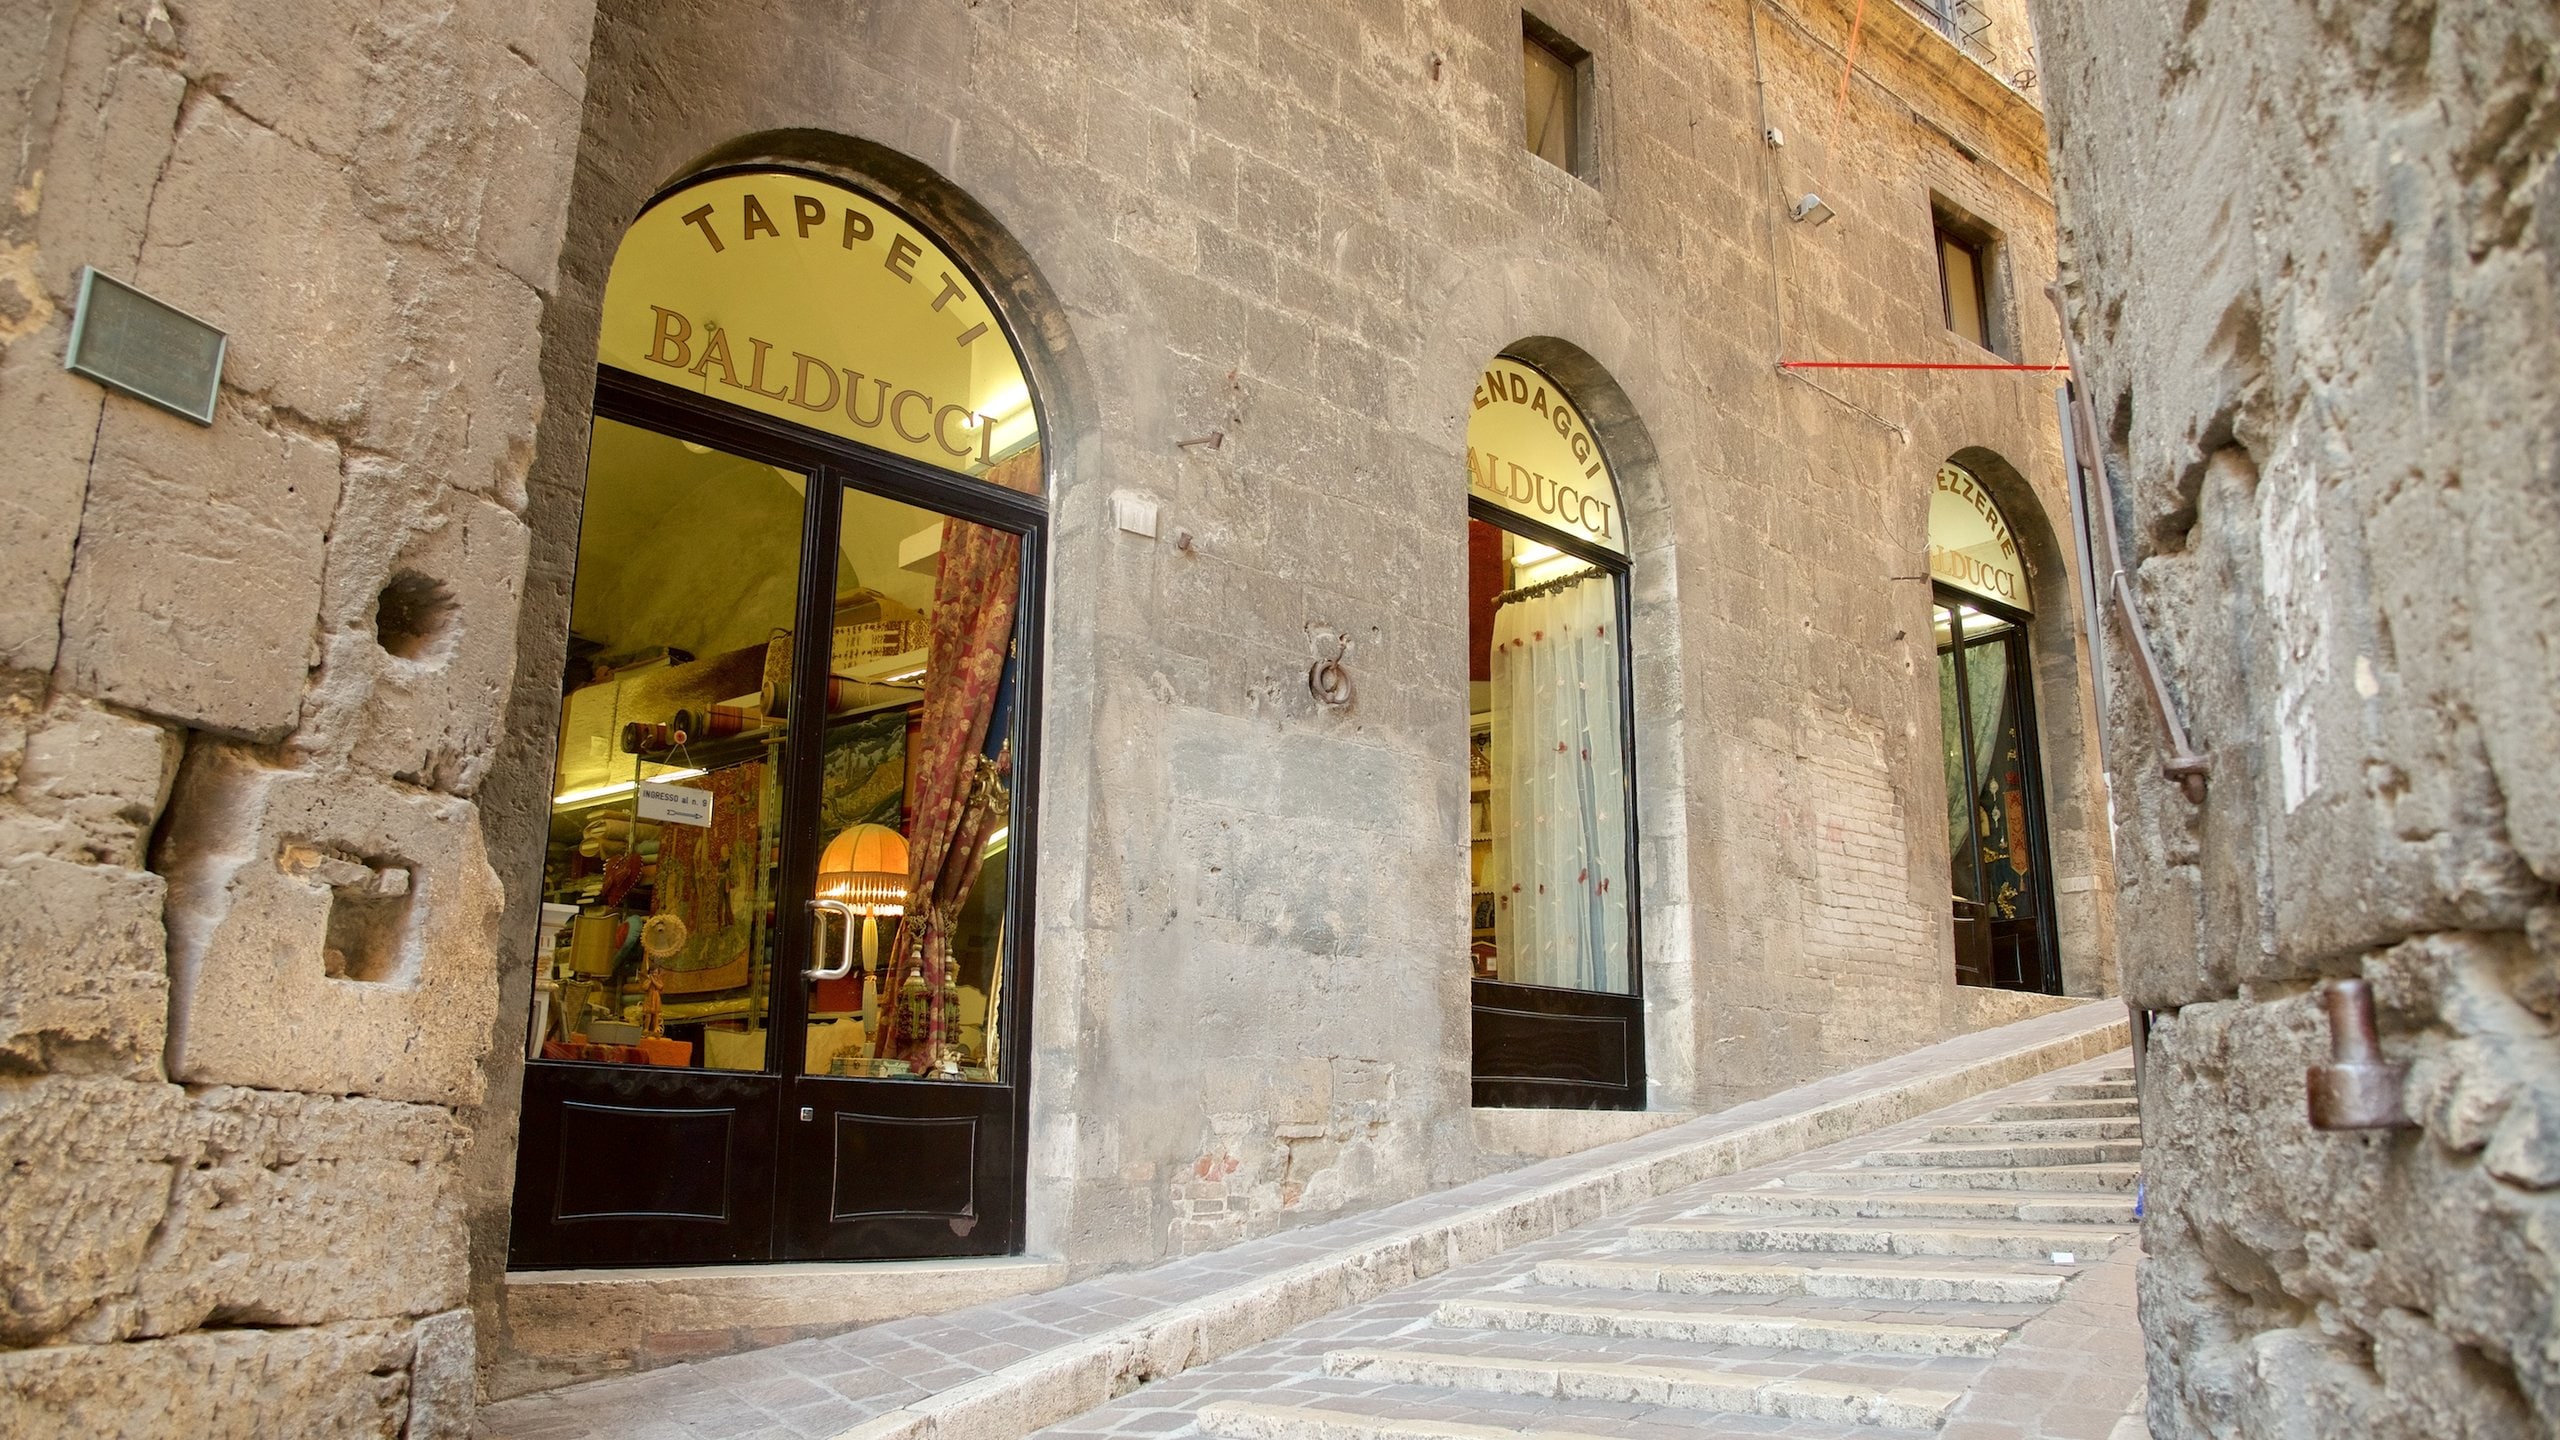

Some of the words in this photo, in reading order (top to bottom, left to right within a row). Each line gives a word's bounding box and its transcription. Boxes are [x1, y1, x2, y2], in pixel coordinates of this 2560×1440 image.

[681, 193, 988, 347] TAPPETI
[644, 305, 998, 467] BALDUCCI
[1470, 370, 1601, 480] ENDAGGI
[1466, 446, 1612, 540] ALDUCCI
[1935, 468, 2015, 560] EZZERIE
[642, 790, 679, 803] INGRESSO
[681, 796, 689, 804] al
